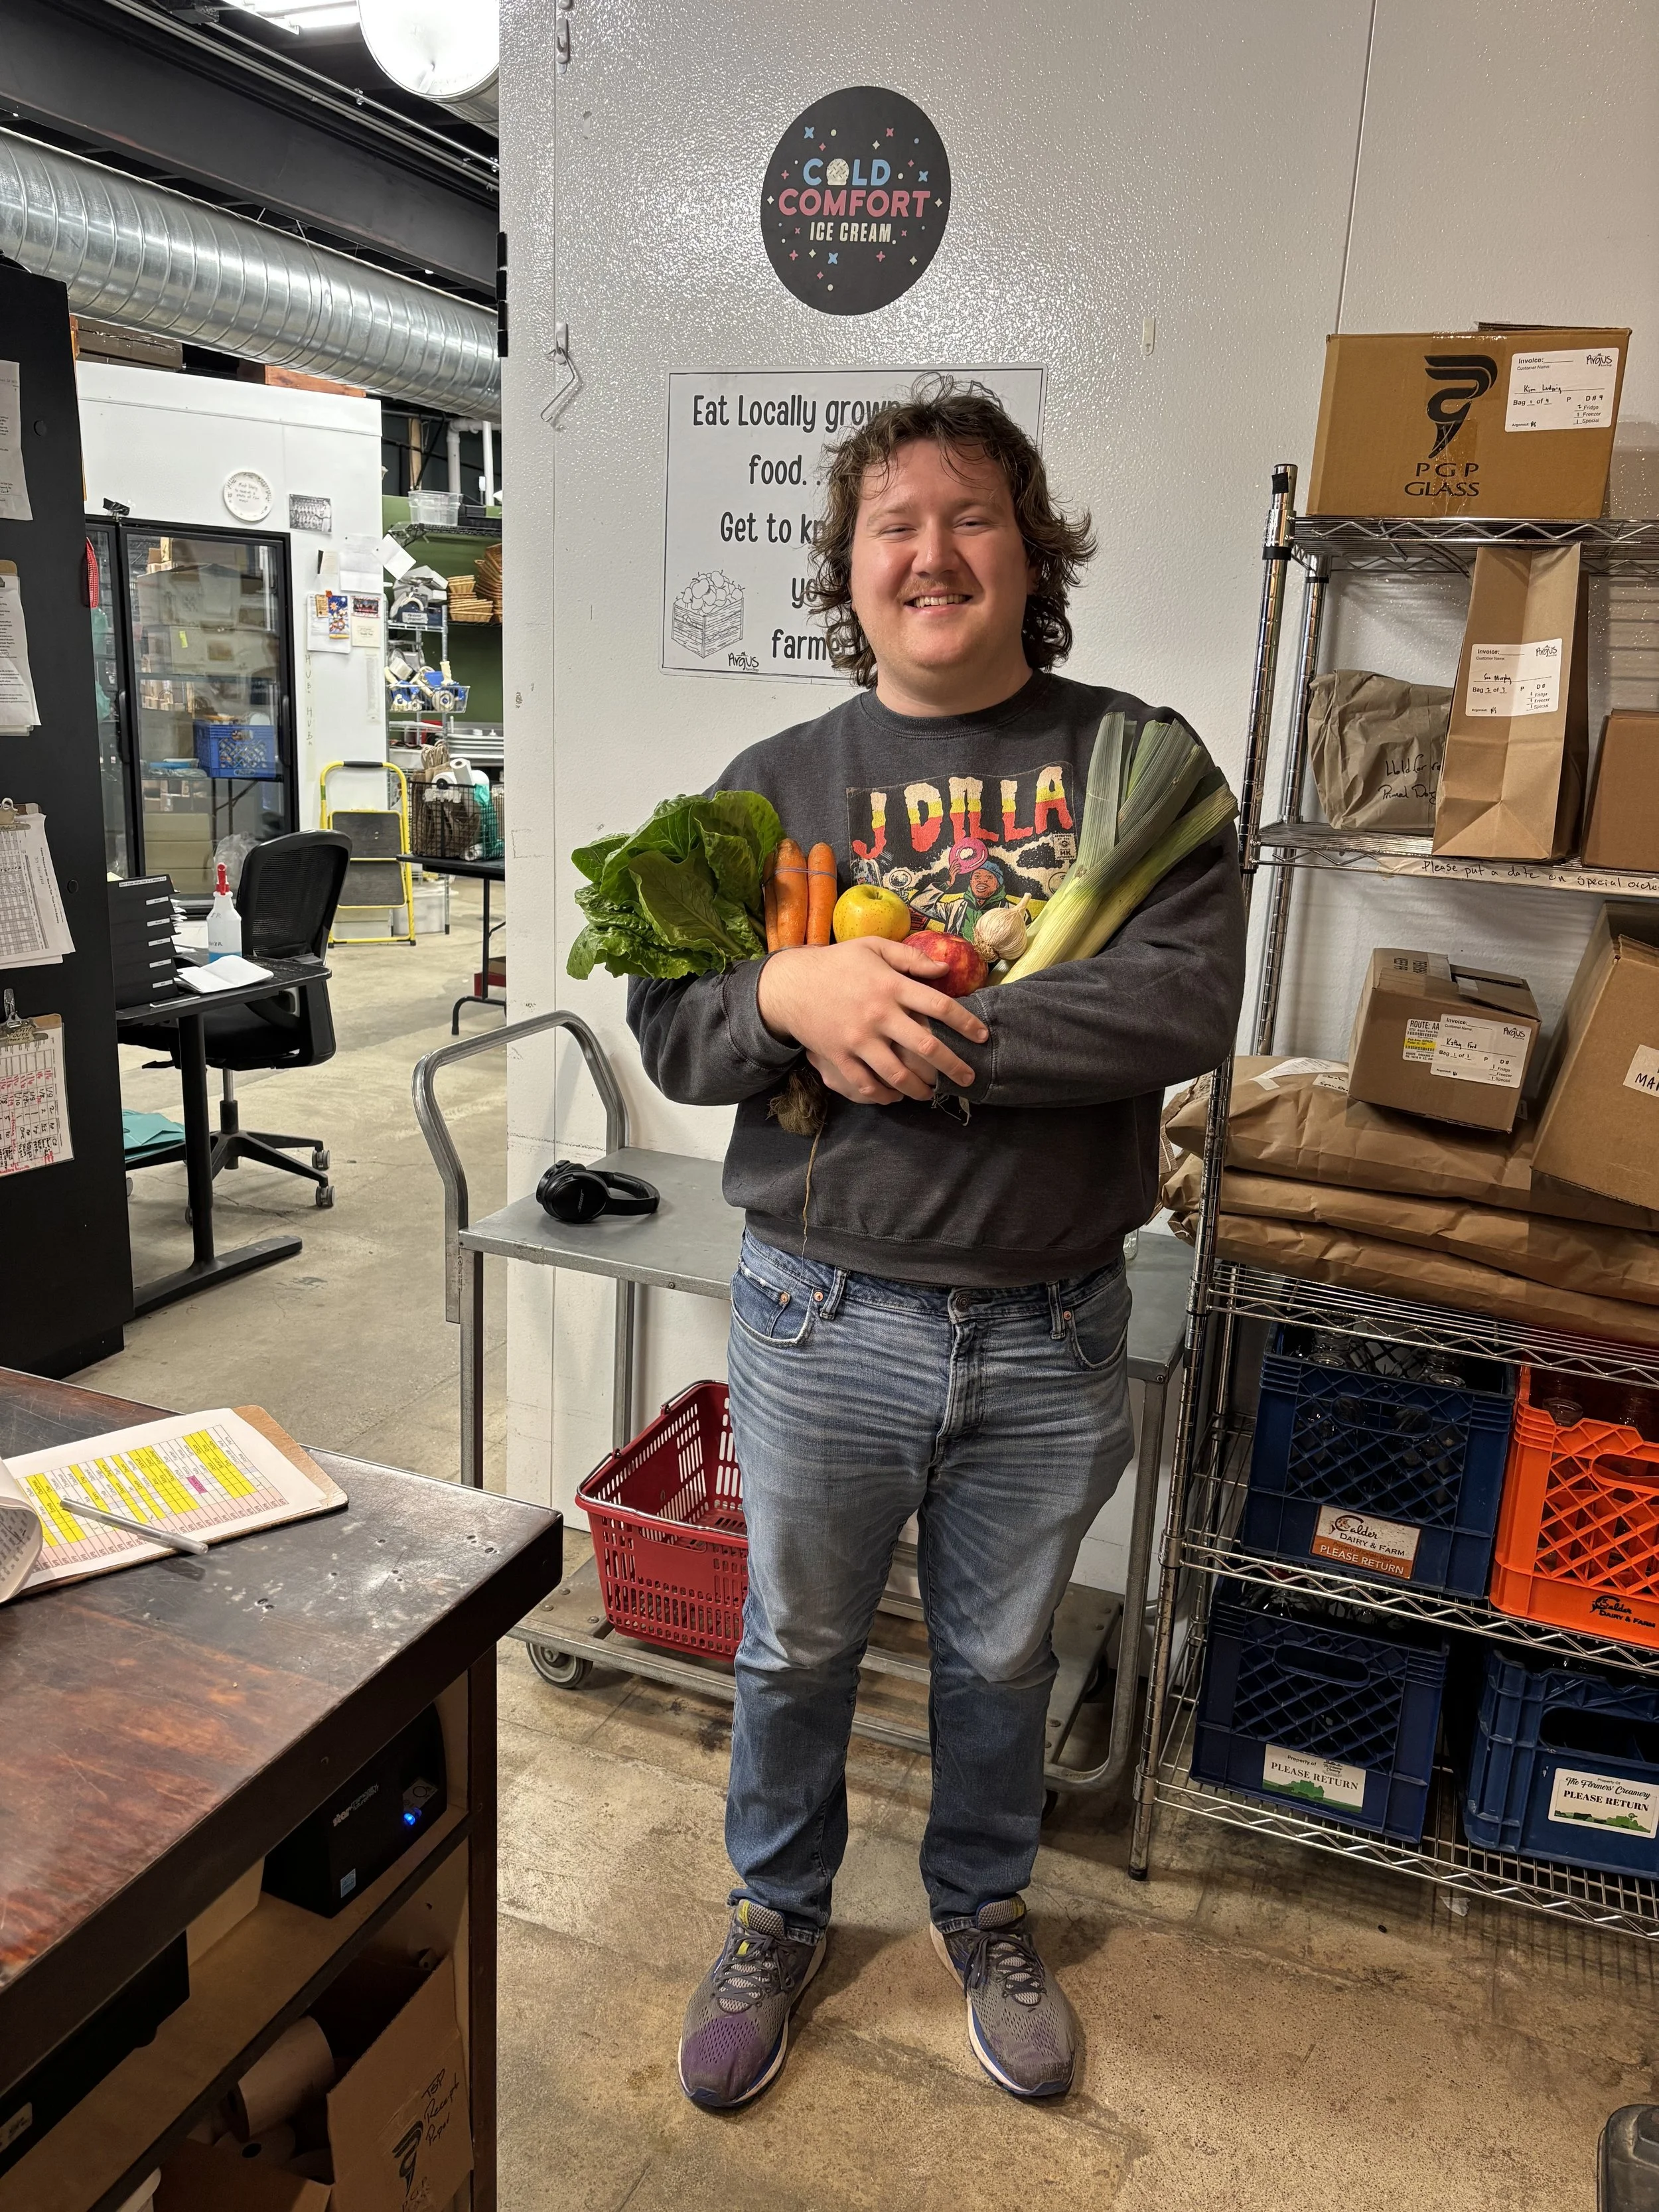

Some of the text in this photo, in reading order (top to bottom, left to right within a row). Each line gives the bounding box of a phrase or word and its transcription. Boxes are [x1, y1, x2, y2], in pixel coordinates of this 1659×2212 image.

[778, 188, 930, 218] COMFORT
[810, 222, 892, 243] ICE CREAM
[1586, 353, 1613, 366] Argus
[1524, 384, 1536, 393] Kim
[693, 395, 729, 426] Eat
[739, 395, 816, 433] Locally
[1404, 482, 1480, 497] GLASS
[720, 511, 758, 542] Get
[766, 513, 792, 543] to
[728, 651, 760, 671] Argus
[1536, 645, 1557, 658] Argus
[1377, 784, 1409, 800] Primal
[852, 765, 1074, 860] J DILLA
[1421, 860, 1458, 874] Please
[1464, 863, 1483, 878] put
[1507, 867, 1540, 880] date
[1410, 1020, 1430, 1029] ROUTE:
[1503, 1027, 1526, 1040] Argus
[1446, 1037, 1462, 1050] Kathy
[1334, 1514, 1378, 1540] Calder
[1340, 1533, 1368, 1548] DAIRY
[1378, 1544, 1405, 1556] FARM
[1320, 1544, 1404, 1575] PLEASE RETURN
[1599, 1609, 1624, 1620] DAIRY
[1632, 1617, 1656, 1628] FARM
[1287, 1754, 1310, 1766] Property
[1271, 1761, 1310, 1779] PLEASE
[1313, 1773, 1359, 1791] RETURN
[1565, 1777, 1579, 1786] The
[1615, 1786, 1651, 1800] Creamery
[1563, 1790, 1650, 1812] PLEASE RETURN
